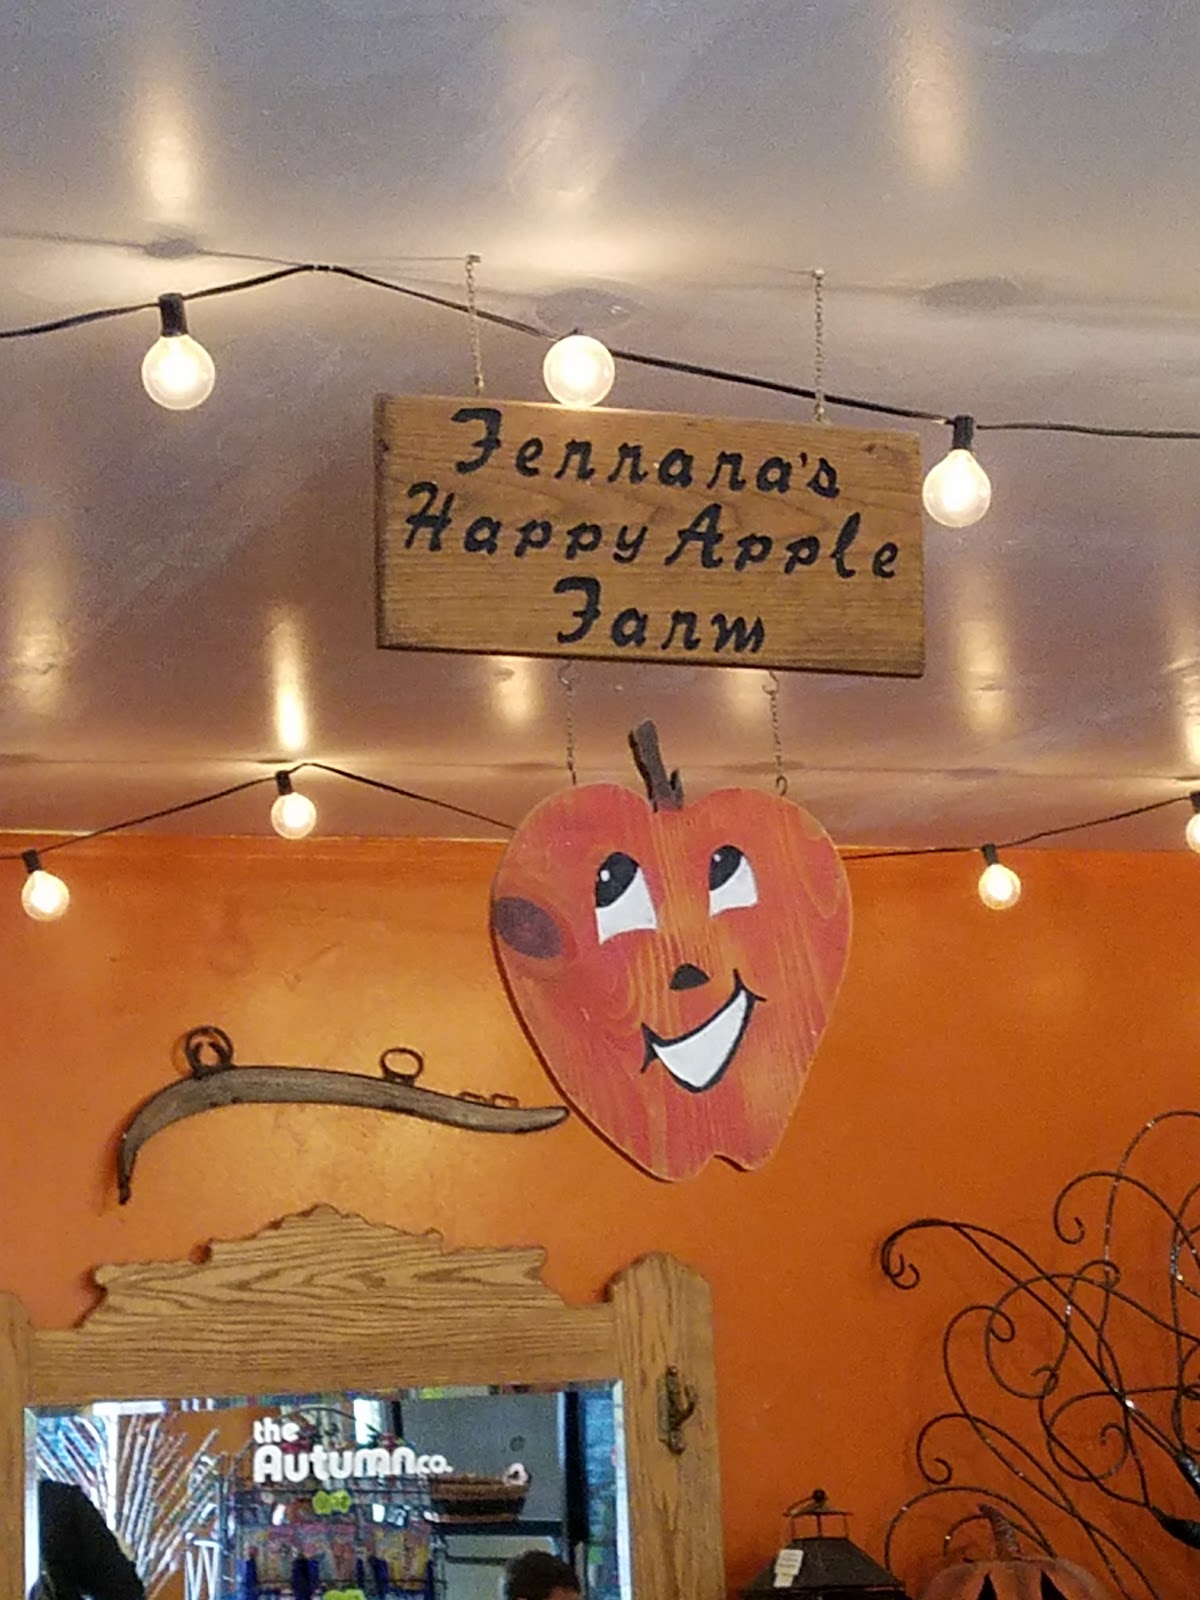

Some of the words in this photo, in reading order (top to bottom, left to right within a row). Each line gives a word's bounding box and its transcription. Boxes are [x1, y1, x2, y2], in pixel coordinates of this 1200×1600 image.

[404, 482, 648, 563] Happy
[664, 503, 900, 580] Apple
[553, 576, 766, 654] Farm
[253, 1417, 300, 1444] the
